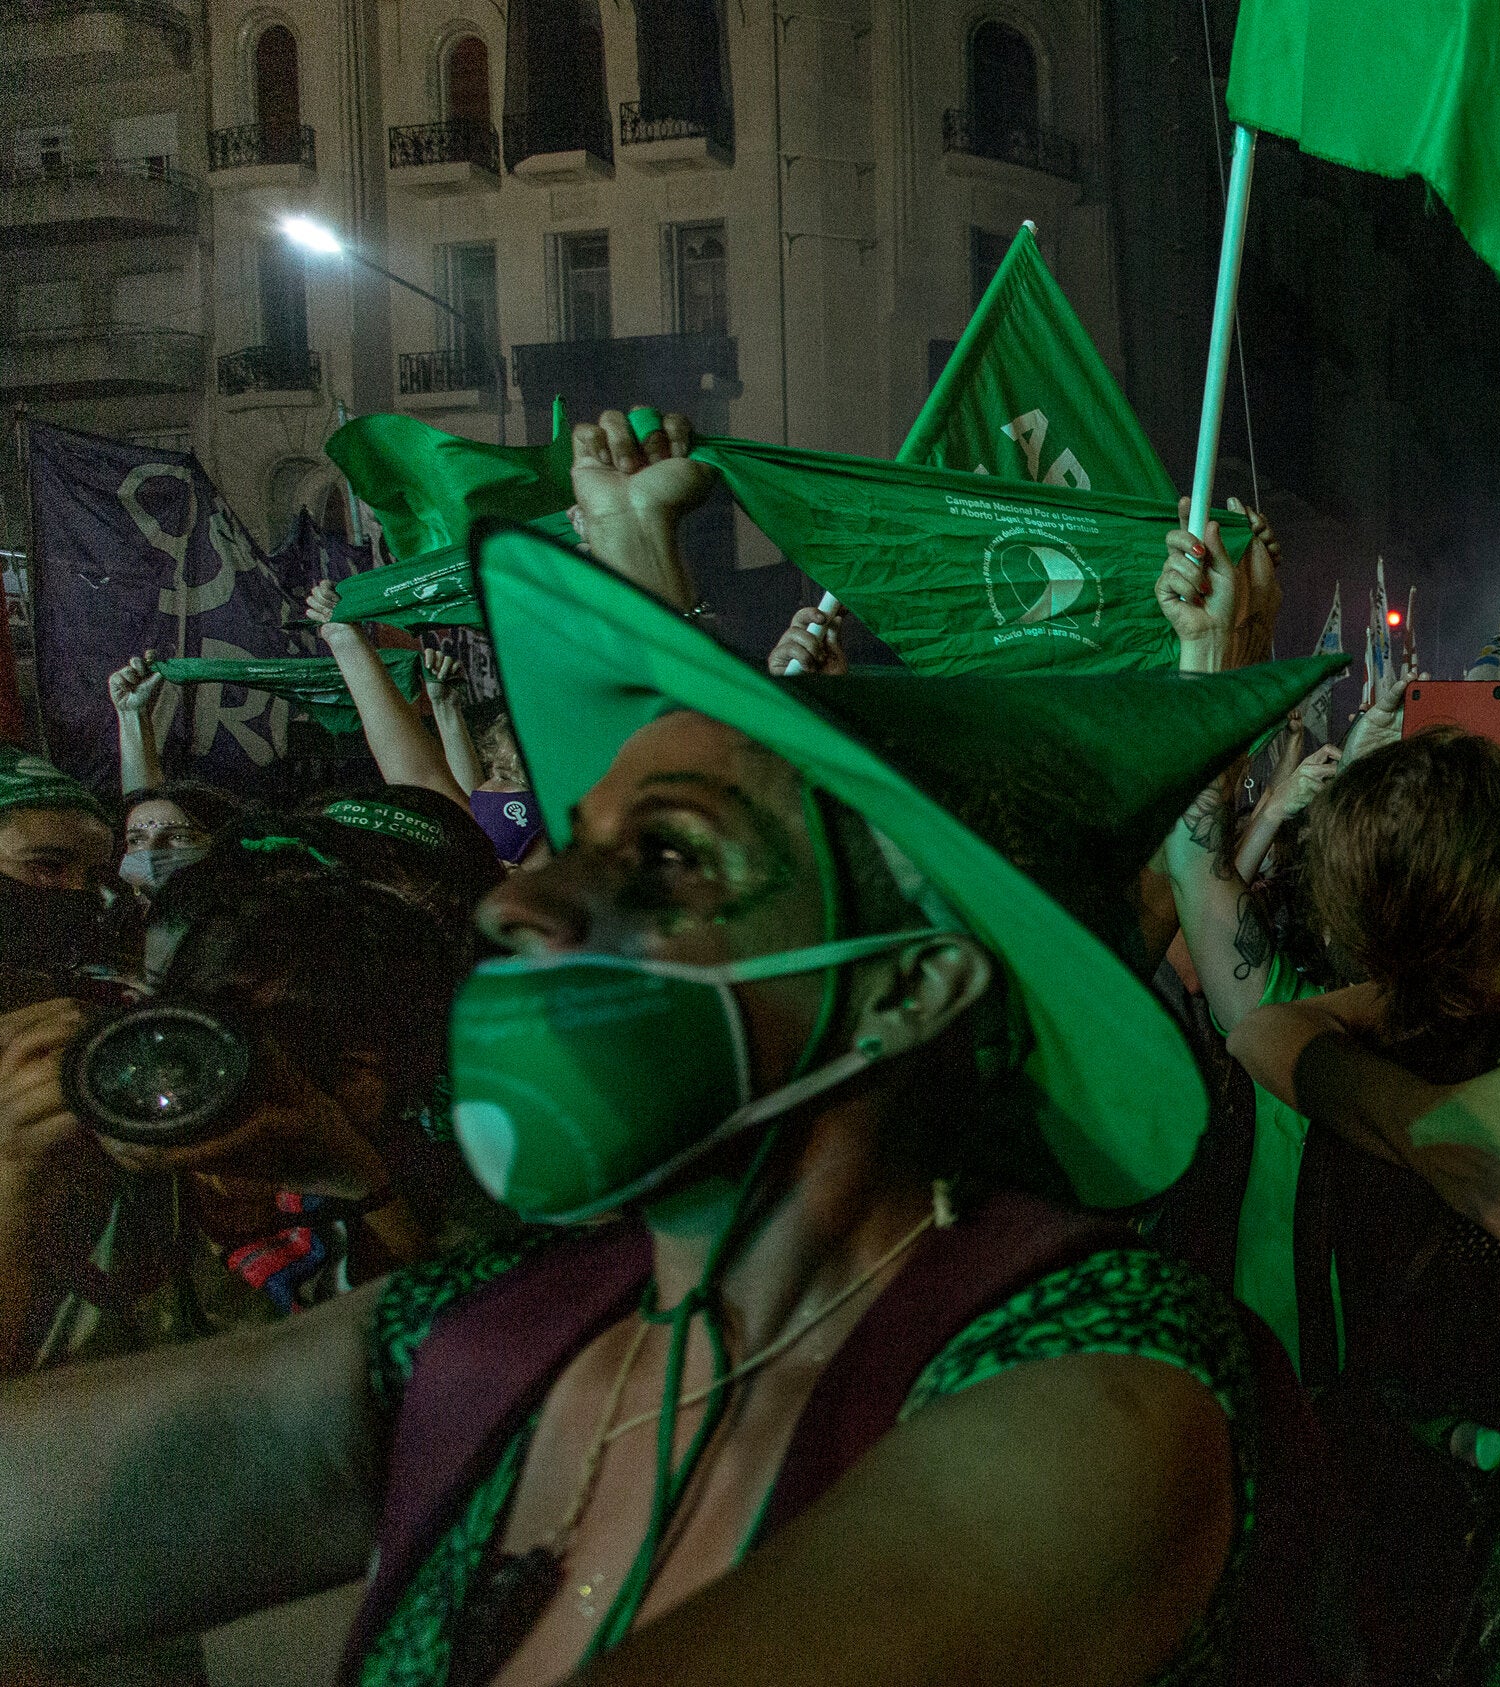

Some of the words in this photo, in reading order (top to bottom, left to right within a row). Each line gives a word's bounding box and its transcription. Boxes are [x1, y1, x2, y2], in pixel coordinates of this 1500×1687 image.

[961, 508, 993, 520] Aborto
[1024, 517, 1057, 528] Seguro
[1058, 523, 1064, 531] y
[992, 502, 1032, 515] Nacional
[1034, 508, 1049, 517] Por
[1069, 632, 1080, 641] no
[393, 812, 440, 834] Derec
[389, 822, 440, 847] Gratuit
